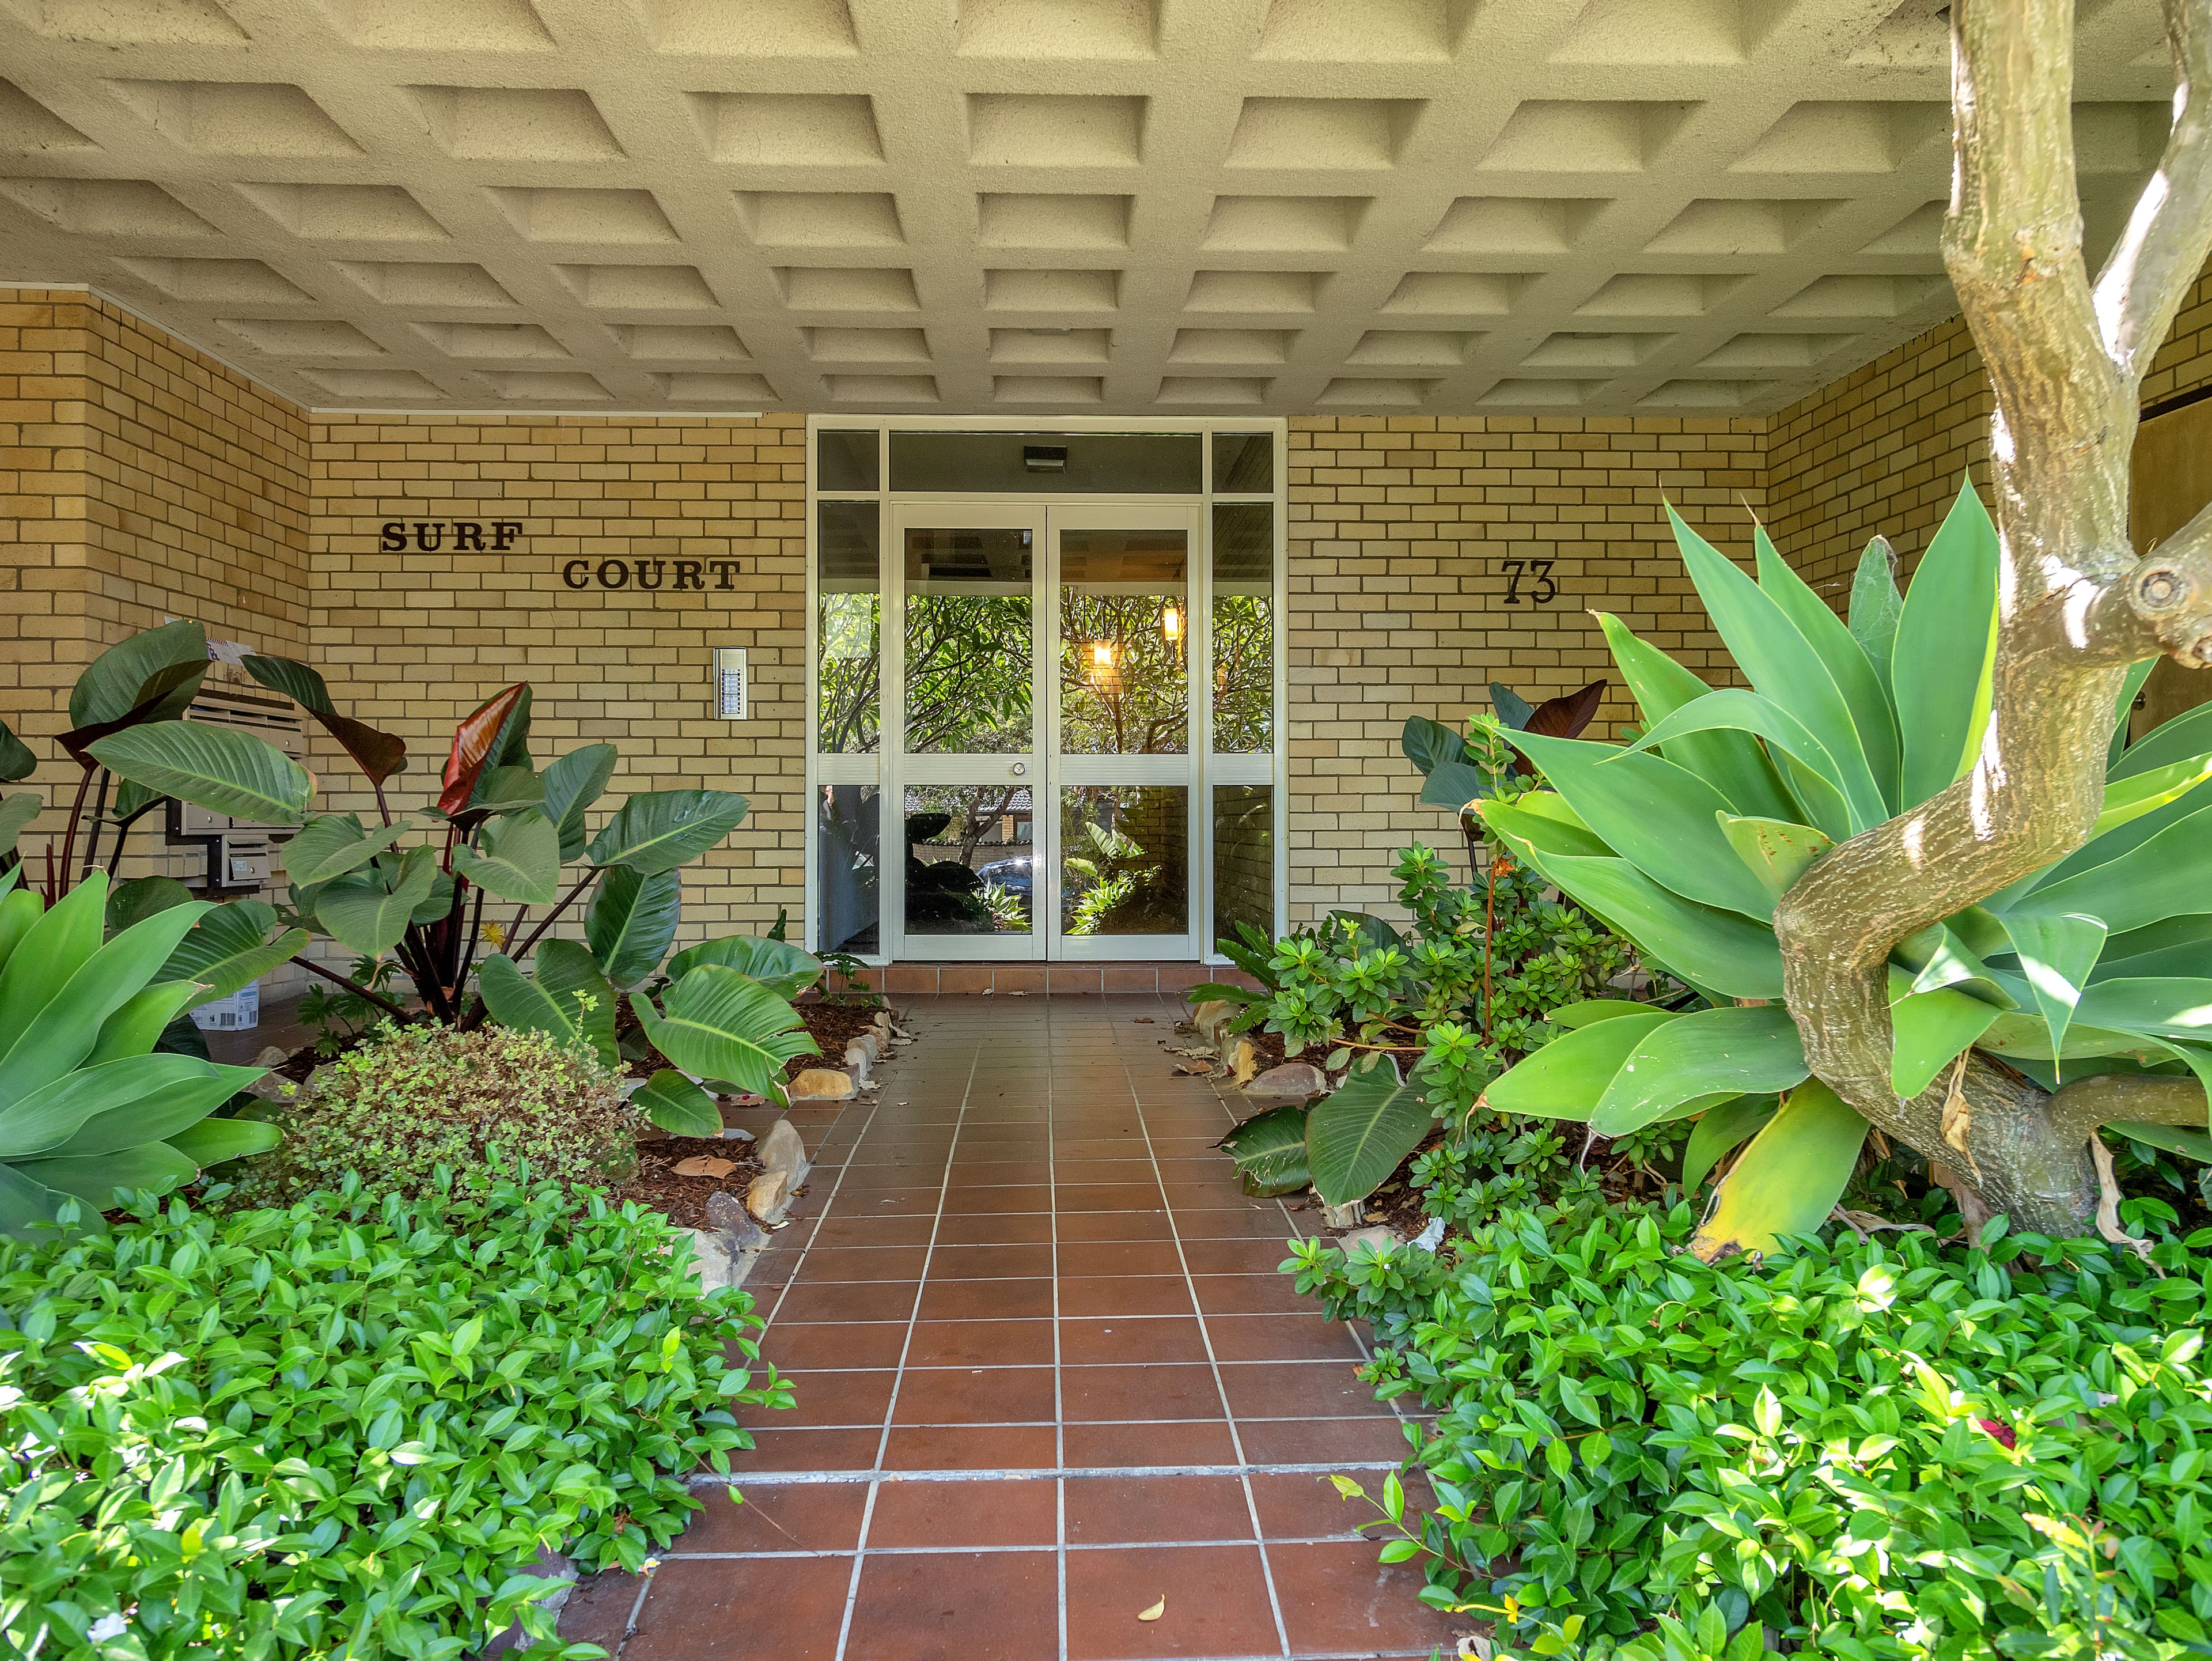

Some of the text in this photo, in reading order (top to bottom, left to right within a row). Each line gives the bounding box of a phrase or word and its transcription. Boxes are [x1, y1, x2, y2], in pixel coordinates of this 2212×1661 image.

[382, 522, 523, 551] SURF
[563, 559, 740, 590] COURT
[1501, 560, 1555, 604] 73
